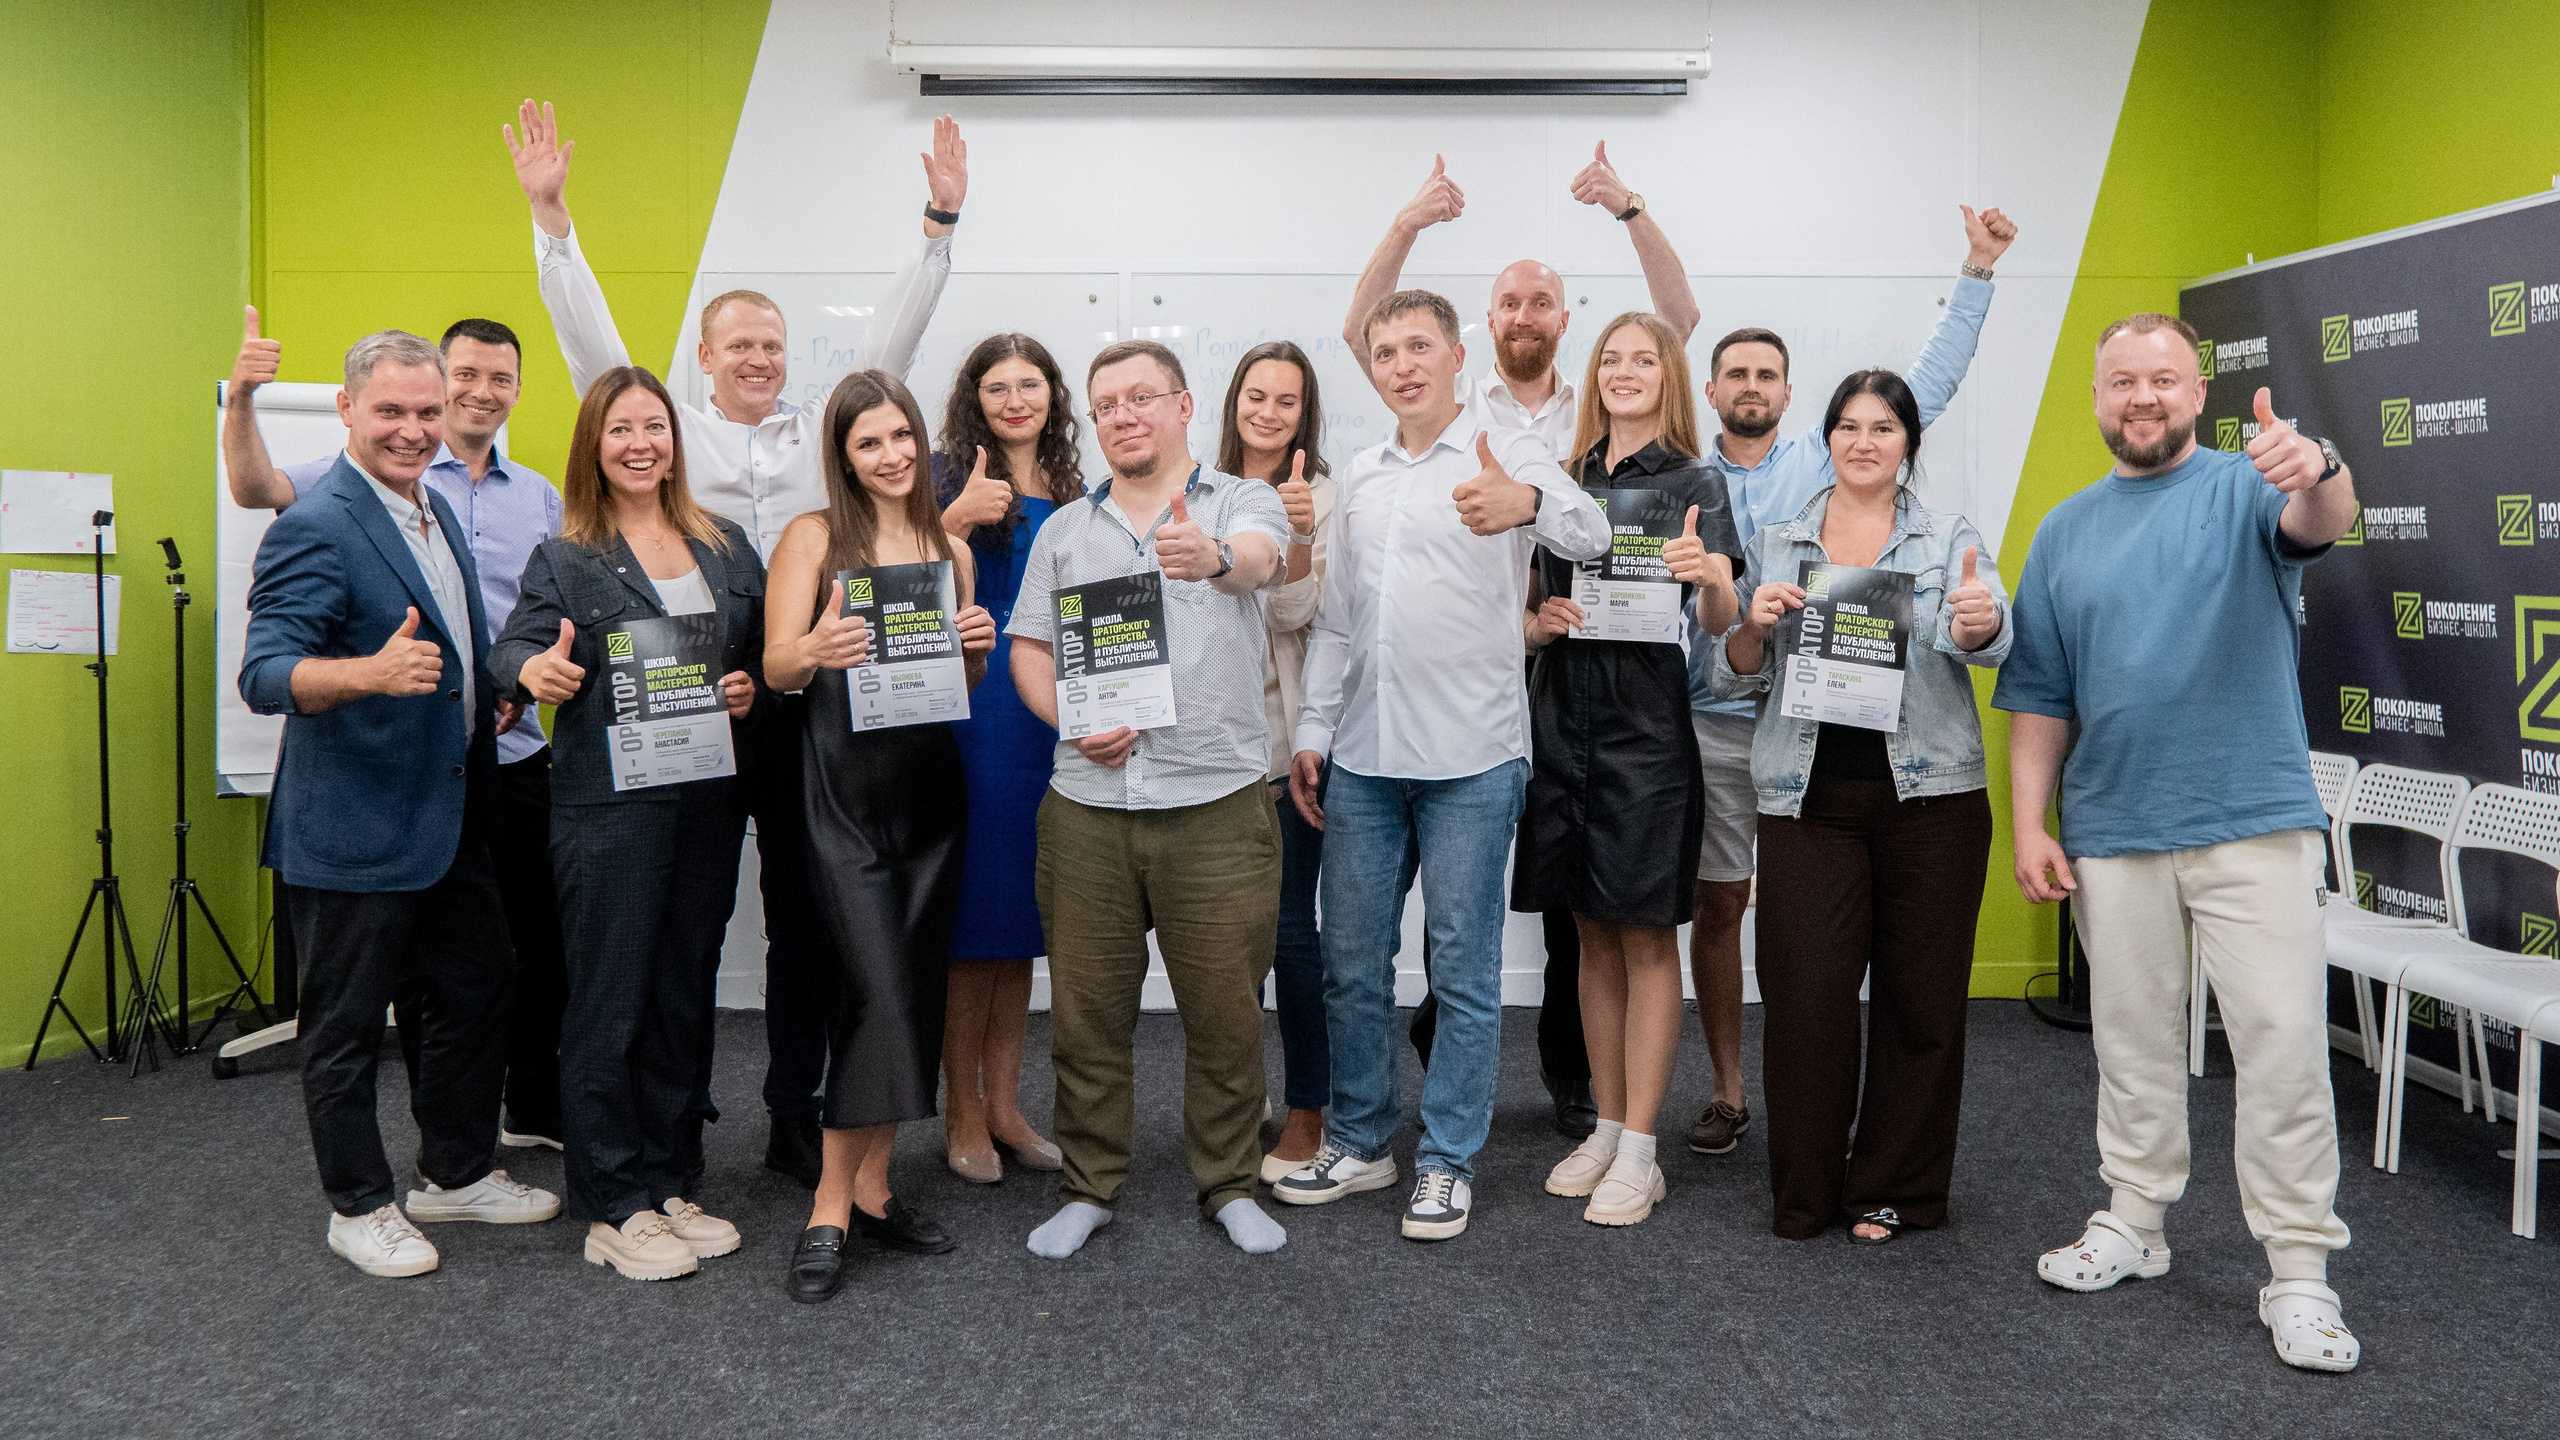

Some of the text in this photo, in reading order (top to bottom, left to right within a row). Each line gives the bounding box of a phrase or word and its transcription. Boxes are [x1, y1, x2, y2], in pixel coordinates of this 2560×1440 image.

[2353, 309, 2418, 337] ПОКОЛЕНИЕ
[2216, 336, 2268, 360] ПОКОЛЕНИЕ
[2354, 329, 2420, 352] БИЗНЕС-ШКОЛА
[2217, 353, 2269, 374] БИЗНЕС-ШКОЛА
[2415, 397, 2487, 423] ПОКОЛЕНИЕ
[2416, 417, 2488, 439] БИЗНЕС-ШКОЛА
[2364, 507, 2426, 525] ПОКОЛЕНИЕ
[1614, 525, 1643, 535] ШКОЛА
[2365, 525, 2428, 540] БИЗНЕС-ШКОЛА
[1613, 535, 1669, 546] ОРАТОРСКОГО
[1613, 546, 1664, 556] МАСТЕРСТВА
[1612, 556, 1670, 567] И ПУБЛИЧНЫ
[883, 602, 915, 614] ШКОЛА
[1836, 602, 1868, 615] ШКОЛА
[2426, 601, 2496, 623] ПОКОЛЕНИЕ
[884, 610, 943, 624] ОРАТОРСКОГО
[1092, 613, 1123, 627] ШКОЛА
[1835, 612, 1894, 630] ОРАТОРСКОГО
[885, 621, 941, 635] МАСТЕРСТВА
[1093, 619, 1150, 637] ОРАТОРСКОГО
[1834, 623, 1889, 639] МАСТЕРСТВА
[2427, 619, 2498, 639] БИЗНЕС-ШКОЛА
[886, 631, 950, 646] И ПУБЛИЧНЫХ
[1094, 630, 1147, 647] МАСТЕРСТВА
[1795, 606, 1825, 685] ОРАТОР
[1832, 634, 1896, 651] И ПУБЛИЧНЫХ
[888, 640, 952, 657] ВЫСТУПЛЕНИЙ
[1094, 639, 1156, 658] И ПУБЛИЧНЫХ
[1831, 644, 1896, 662] ВЫСТУПЛЕНИЙ
[644, 656, 677, 669] ШКОЛА
[1095, 649, 1159, 668] ВЫСТУПЛЕНИЙ
[645, 664, 706, 680] ОРАТОРСКОГО
[1061, 630, 1088, 705] ОРАТОР
[647, 676, 704, 691] МАСТЕРСТВА
[892, 680, 926, 691] ЕКАТЕРИНА
[1098, 681, 1129, 692] КАРТУШИН
[1827, 680, 1846, 689] ЕЛЕНА
[648, 685, 713, 703] И ПУБЛИЧНЫХ
[1098, 691, 1118, 701] АНТОН
[612, 672, 643, 752] ОРАТОР
[649, 696, 716, 714] ВЫСТУПЛЕНИЙ
[1791, 703, 1813, 718] Я
[2374, 697, 2443, 722] ПОКОЛЕНИЕ
[863, 714, 885, 728] Я
[2374, 715, 2445, 738] БИЗНЕС-ШКОЛА
[653, 728, 692, 739] ЧЕРЕПАНОВА
[1069, 722, 1091, 737] Я
[654, 737, 690, 748] АНАСТАСИЯ
[625, 773, 648, 787] Я
[2378, 884, 2446, 917] ПОКОЛЕНИЕ
